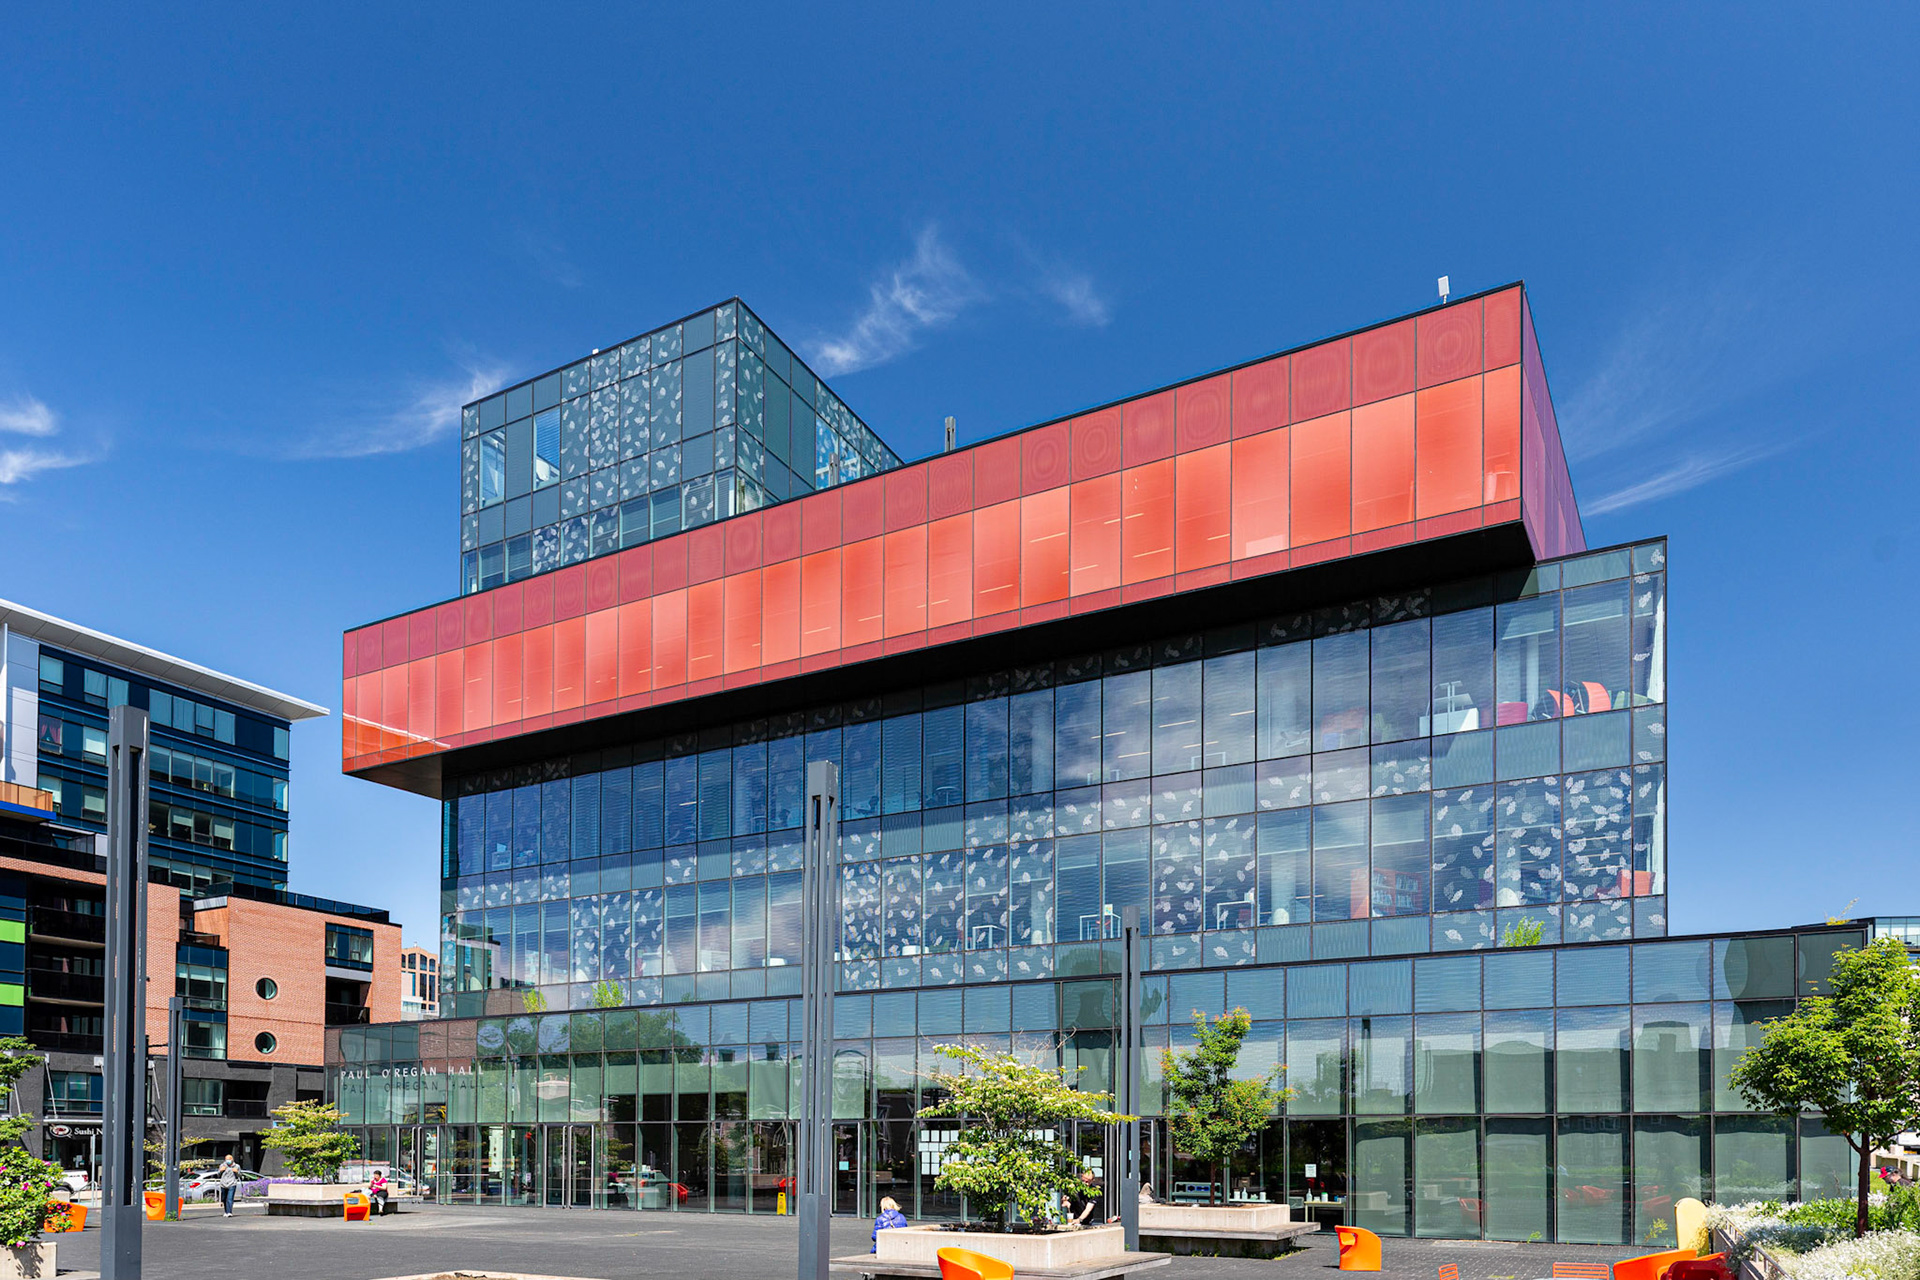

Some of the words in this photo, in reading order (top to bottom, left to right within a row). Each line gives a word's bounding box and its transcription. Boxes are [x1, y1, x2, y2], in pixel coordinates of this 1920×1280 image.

[340, 1069, 370, 1080] PAUL
[381, 1067, 437, 1079] O'REGAN
[447, 1065, 484, 1076] HALL
[74, 1127, 95, 1135] Sushi
